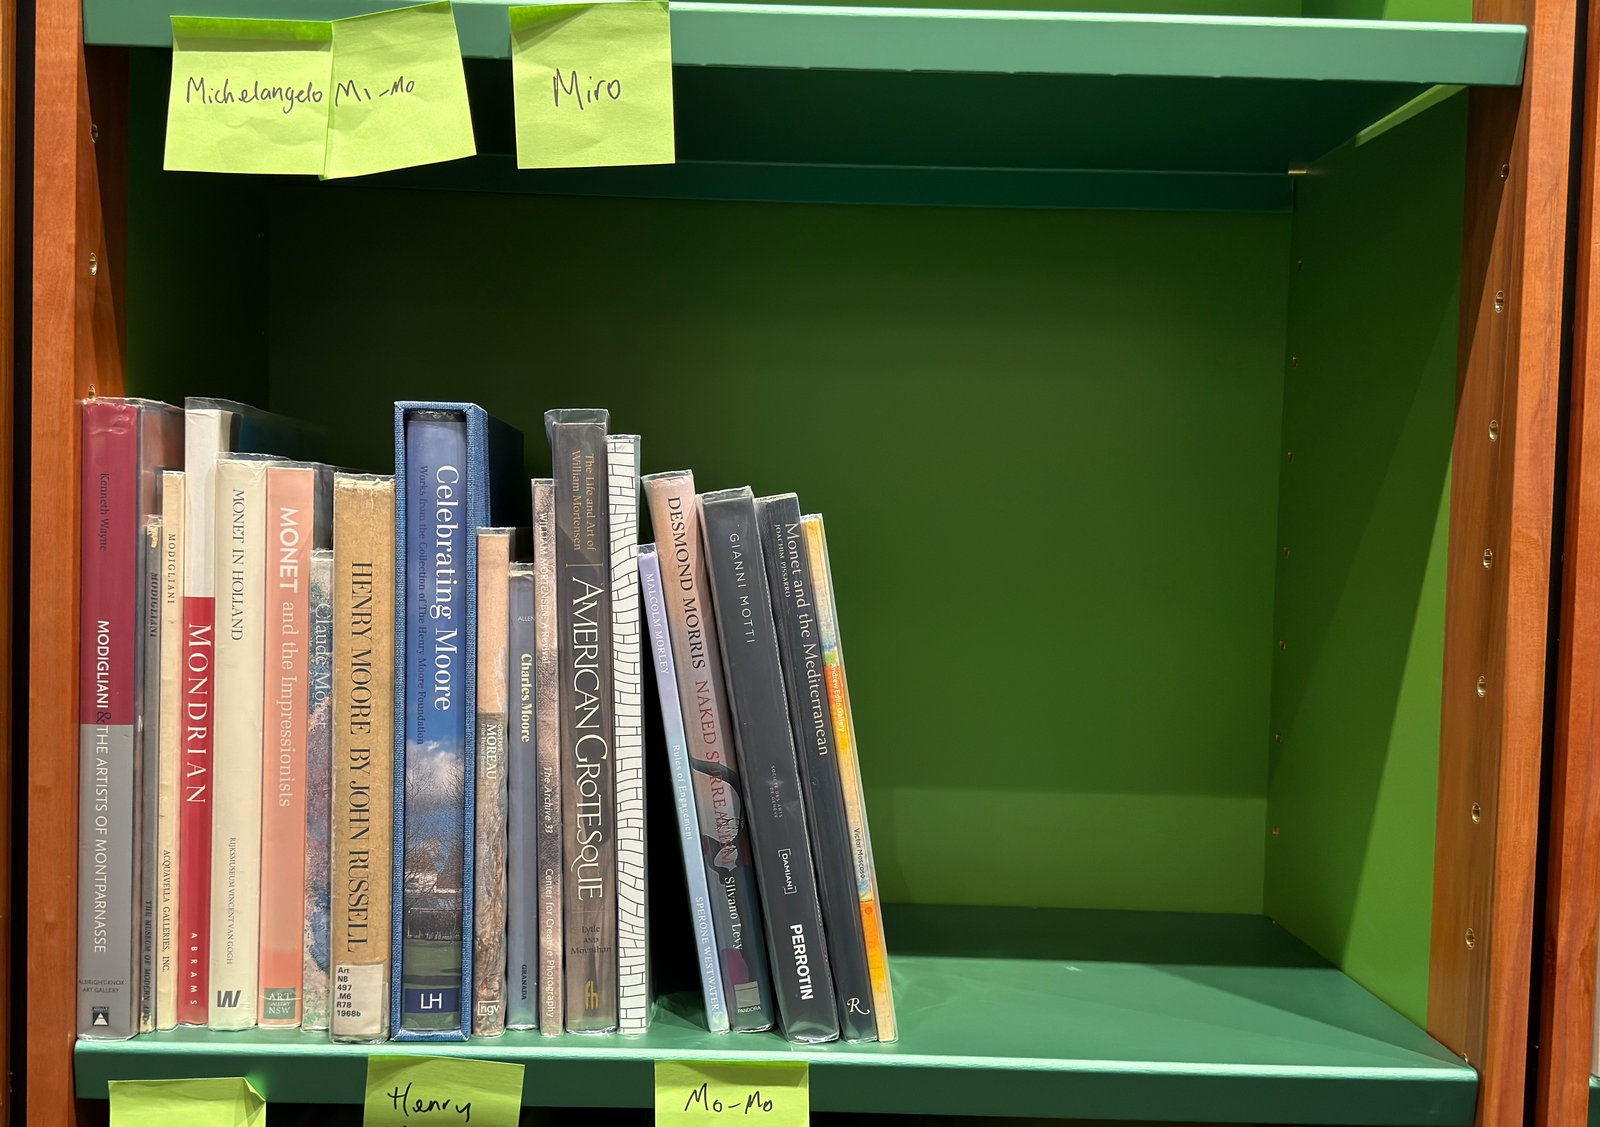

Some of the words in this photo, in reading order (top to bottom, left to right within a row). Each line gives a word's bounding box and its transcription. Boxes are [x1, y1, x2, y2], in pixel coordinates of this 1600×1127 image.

[186, 75, 323, 114] Michelangelo
[553, 69, 621, 110] Miro
[418, 465, 428, 496] Works
[571, 450, 582, 492] William
[584, 453, 595, 474] The
[99, 472, 110, 515] Kenneth
[584, 476, 595, 496] Life
[232, 489, 245, 543] MONET
[418, 498, 428, 522] from
[572, 494, 583, 551] Mortensen
[585, 498, 595, 519] and
[97, 518, 110, 552] Wayne
[418, 524, 428, 540] the
[429, 465, 460, 620] Celebrating
[539, 512, 548, 555] WILLIAM
[586, 521, 596, 538] Art
[586, 540, 596, 551] of
[668, 497, 694, 591] DESMOND
[774, 523, 786, 559] JOACHIM
[784, 523, 801, 574] Monet
[167, 533, 177, 604] MODIGLIANI
[232, 549, 244, 565] IN
[279, 507, 299, 592] MONET
[418, 541, 427, 591] Collection
[417, 592, 427, 604] of
[729, 533, 747, 588] GIANNI
[739, 596, 755, 645] MOTTI
[779, 561, 791, 598] PISSARRO
[793, 580, 808, 608] and
[149, 572, 159, 638] MODIGLIANI
[231, 570, 244, 641] HOLLAND
[281, 602, 296, 635] and
[351, 561, 373, 641] HENRY
[417, 605, 427, 624] The
[645, 573, 663, 628] MALCOLM
[315, 603, 333, 665] Claude
[416, 626, 427, 655] Henry
[682, 597, 705, 670] MORRIS
[796, 613, 812, 638] the
[96, 620, 110, 709] MODIGLIANI
[281, 642, 296, 669] the
[540, 631, 550, 664] Revival
[572, 576, 604, 729] AMERICAN
[651, 630, 669, 675] MORLEY
[417, 657, 426, 689] Moore
[434, 627, 458, 711] Moore
[521, 653, 533, 702] Charles
[831, 663, 839, 689] Andrew
[349, 648, 372, 734] MOORE
[802, 643, 828, 756] Mediterranean
[834, 689, 842, 707] Edlin
[96, 711, 112, 723] &
[186, 624, 212, 803] MONDRIAN
[416, 691, 426, 745] Foundation
[521, 703, 533, 742] Moore
[695, 680, 717, 745] NAKED
[836, 708, 845, 732] Gallery
[96, 725, 109, 753] THE
[276, 676, 297, 807] Impressionists
[486, 724, 497, 780] MOREAU
[672, 744, 684, 770] Rules
[349, 747, 371, 776] BY
[544, 766, 553, 783] The
[676, 773, 686, 782] of
[95, 757, 108, 812] ARTISTS
[544, 786, 554, 822] Archive
[95, 815, 107, 835] OF
[349, 780, 370, 842] JOHN
[545, 824, 554, 833] 33
[570, 734, 608, 901] GROTESQUE
[678, 785, 693, 840] Engagement
[162, 850, 171, 903] ACQUAVELLA
[228, 837, 237, 888] RIJKSMUSEUM
[857, 849, 866, 879] Moscoso
[93, 839, 107, 953] MONTPARNASSE
[347, 849, 369, 953] RUSSELL
[545, 868, 554, 900] Center
[724, 876, 739, 920] Silvano
[227, 888, 236, 921] VINCENT
[545, 902, 555, 916] for
[144, 919, 152, 952] MUSEUM
[161, 906, 170, 952] GALLERIES,
[227, 923, 235, 940] VAN
[545, 918, 555, 957] Creative
[730, 923, 744, 950] Levy
[144, 955, 151, 964] OF
[162, 956, 170, 972] INC.
[190, 932, 199, 1005] ABRAMS
[226, 941, 234, 965] GOGH
[695, 896, 709, 944] SPERONE
[702, 947, 719, 1011] WESTWATER
[789, 923, 814, 1000] PERROTIN
[143, 968, 151, 1001] MODERN
[269, 992, 291, 1001] ART
[421, 993, 442, 1008] LH
[545, 959, 556, 1018] Photography
[268, 1006, 290, 1014] NSW
[480, 1003, 500, 1015] ngv
[387, 1082, 471, 1122] Henry
